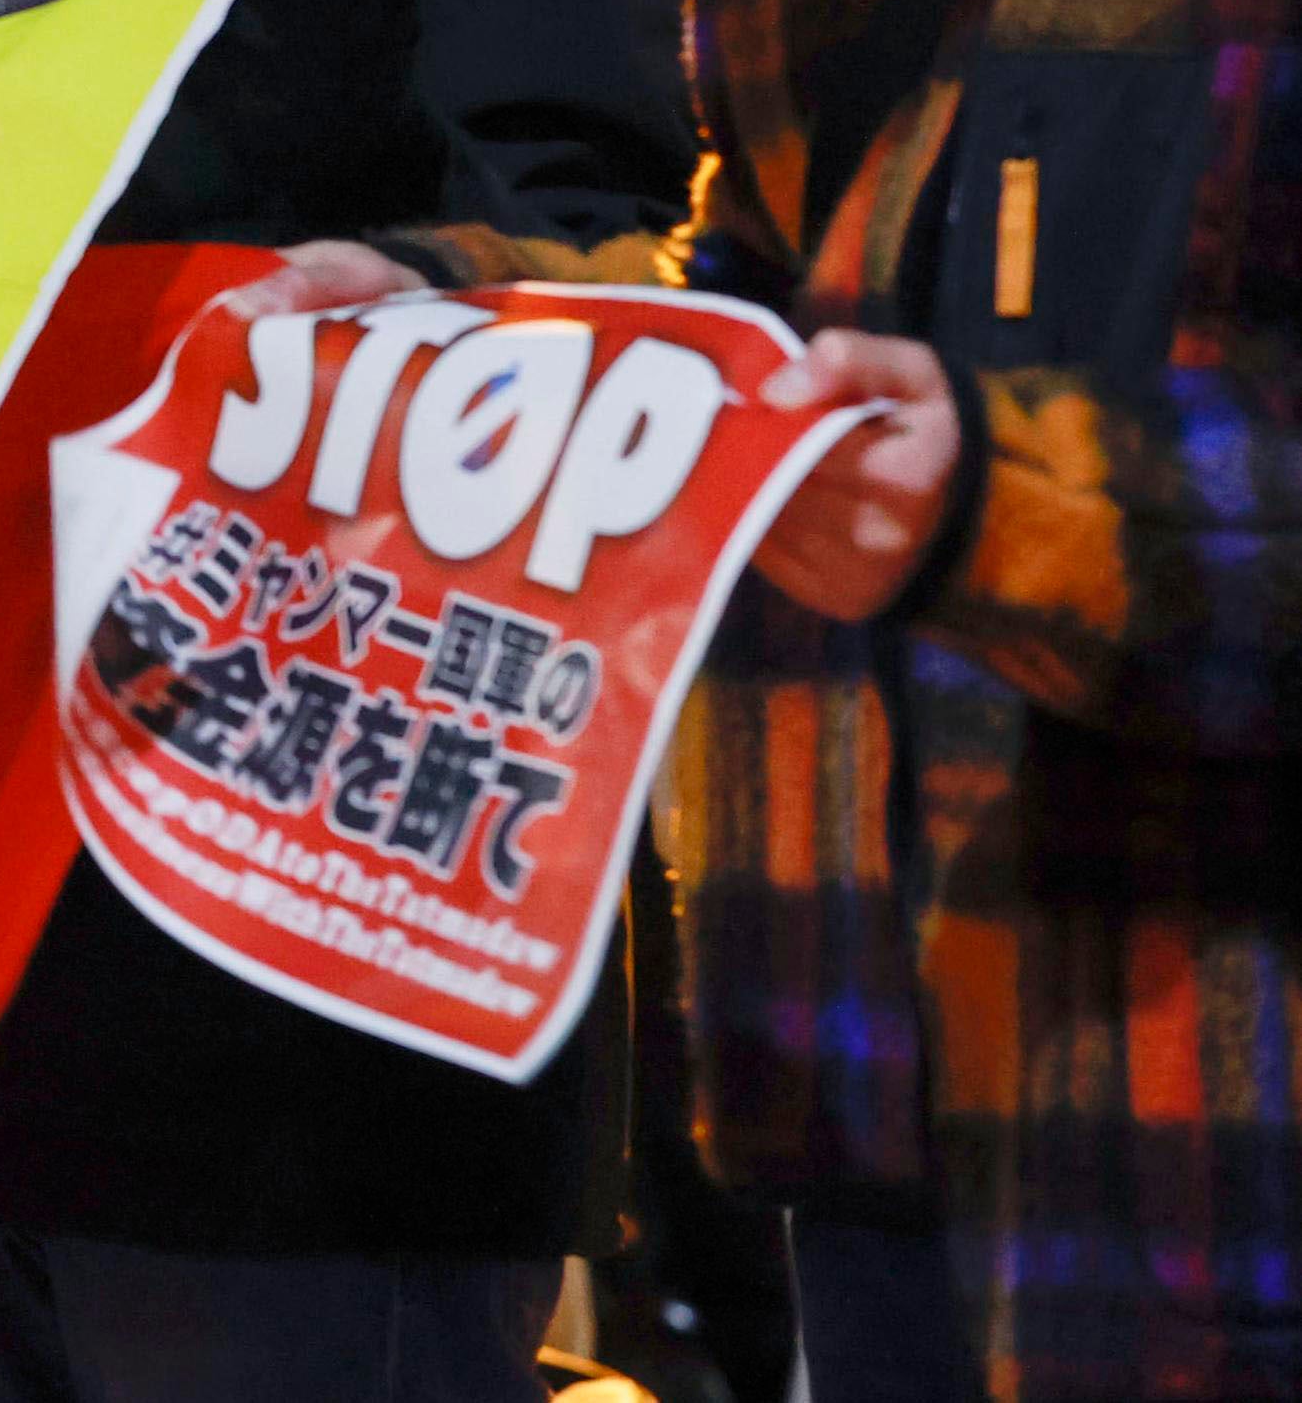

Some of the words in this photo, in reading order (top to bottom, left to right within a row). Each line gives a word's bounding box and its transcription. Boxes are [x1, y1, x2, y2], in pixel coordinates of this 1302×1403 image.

[209, 301, 726, 594] STOP
[138, 504, 599, 745] #ミャンマー国軍の
